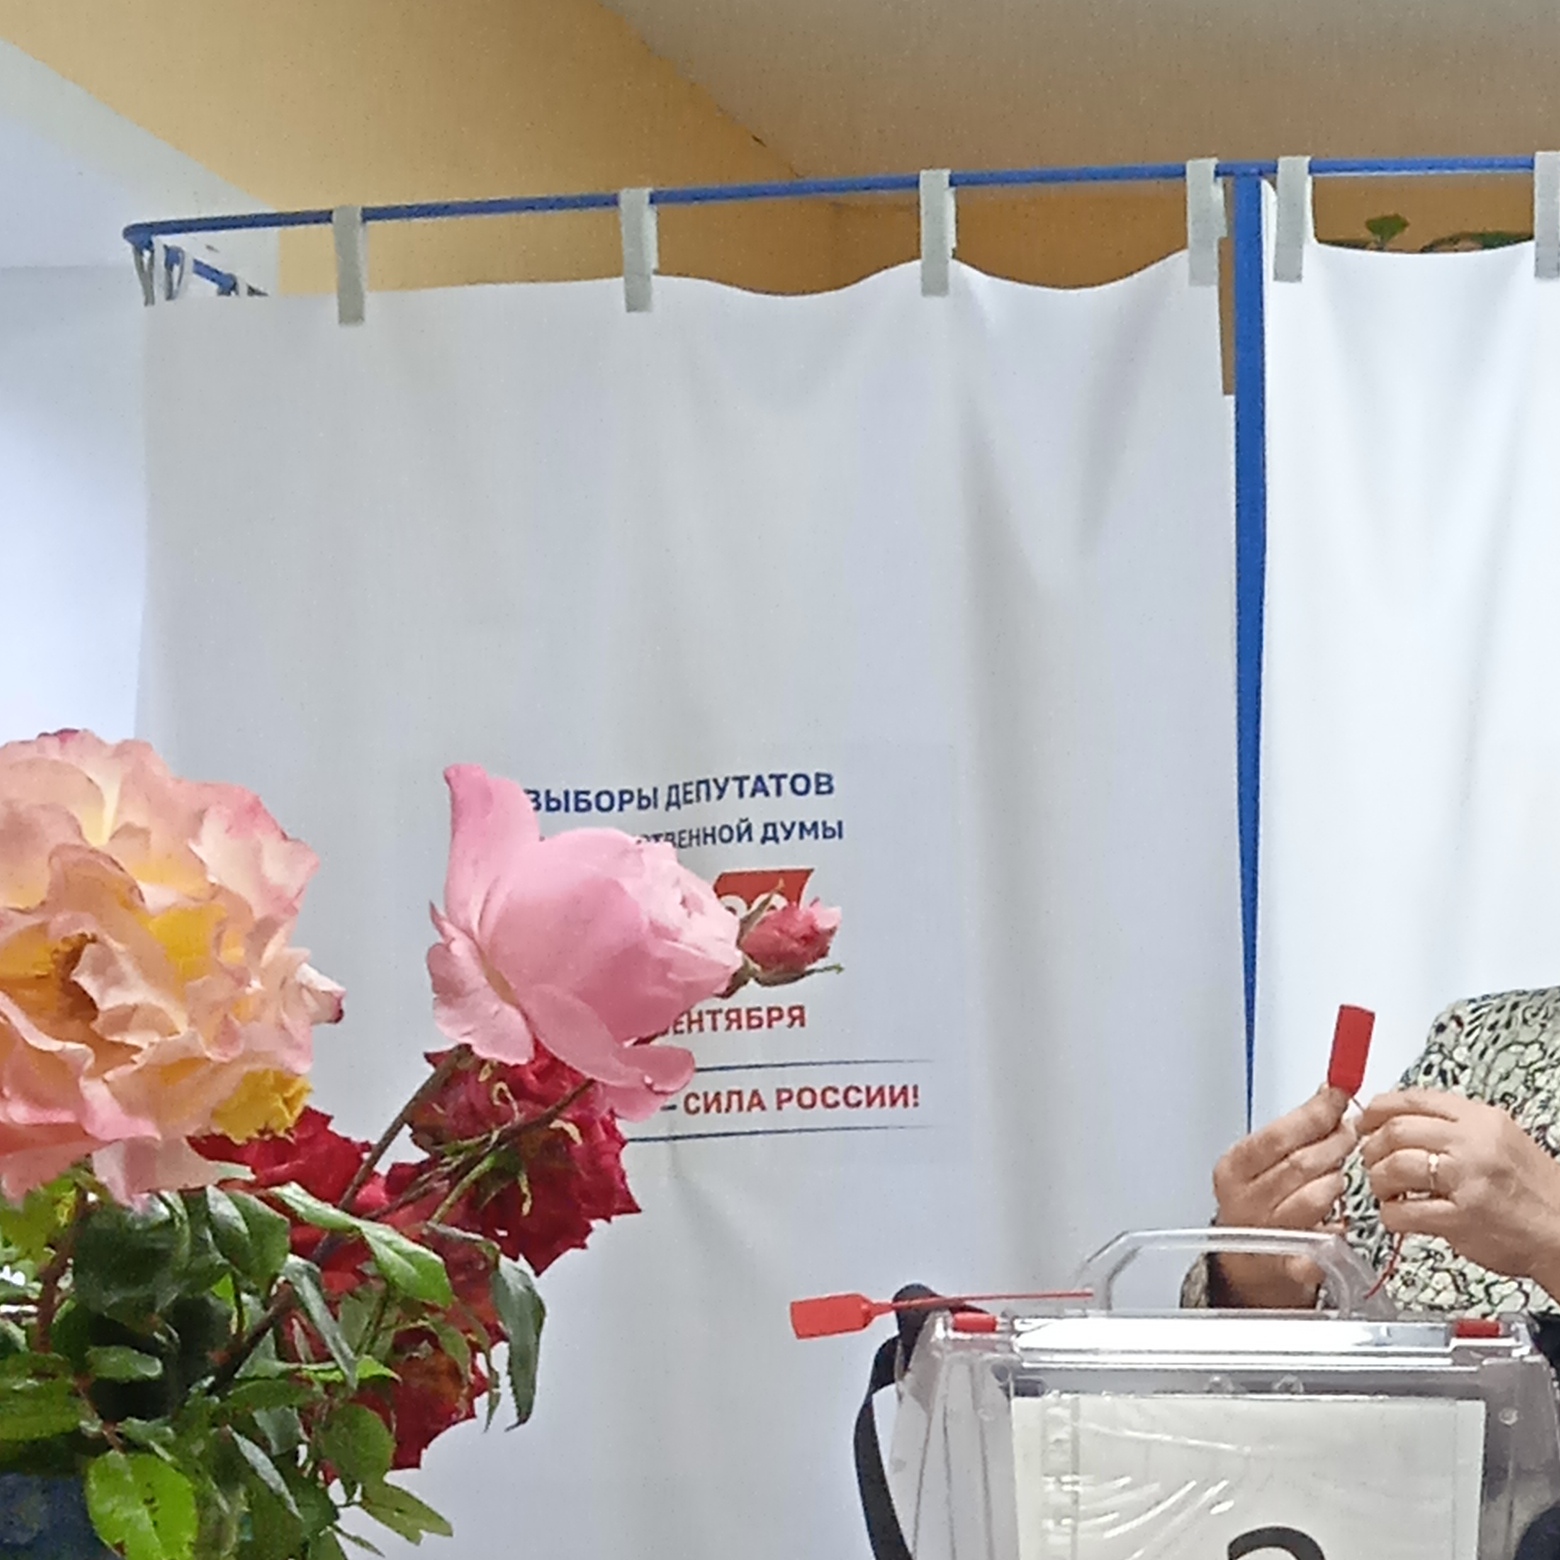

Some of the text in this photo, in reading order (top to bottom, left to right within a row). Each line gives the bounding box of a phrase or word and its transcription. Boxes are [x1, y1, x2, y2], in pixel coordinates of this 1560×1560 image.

[525, 772, 835, 813] ВЫБОРЫ ДЕПУТАТОВ
[760, 820, 843, 846] ДУМЫ
[664, 1004, 806, 1037] ЕНТЯБРЯ
[683, 1088, 766, 1116] СИЛА
[775, 1084, 920, 1112] РОССИИ!
